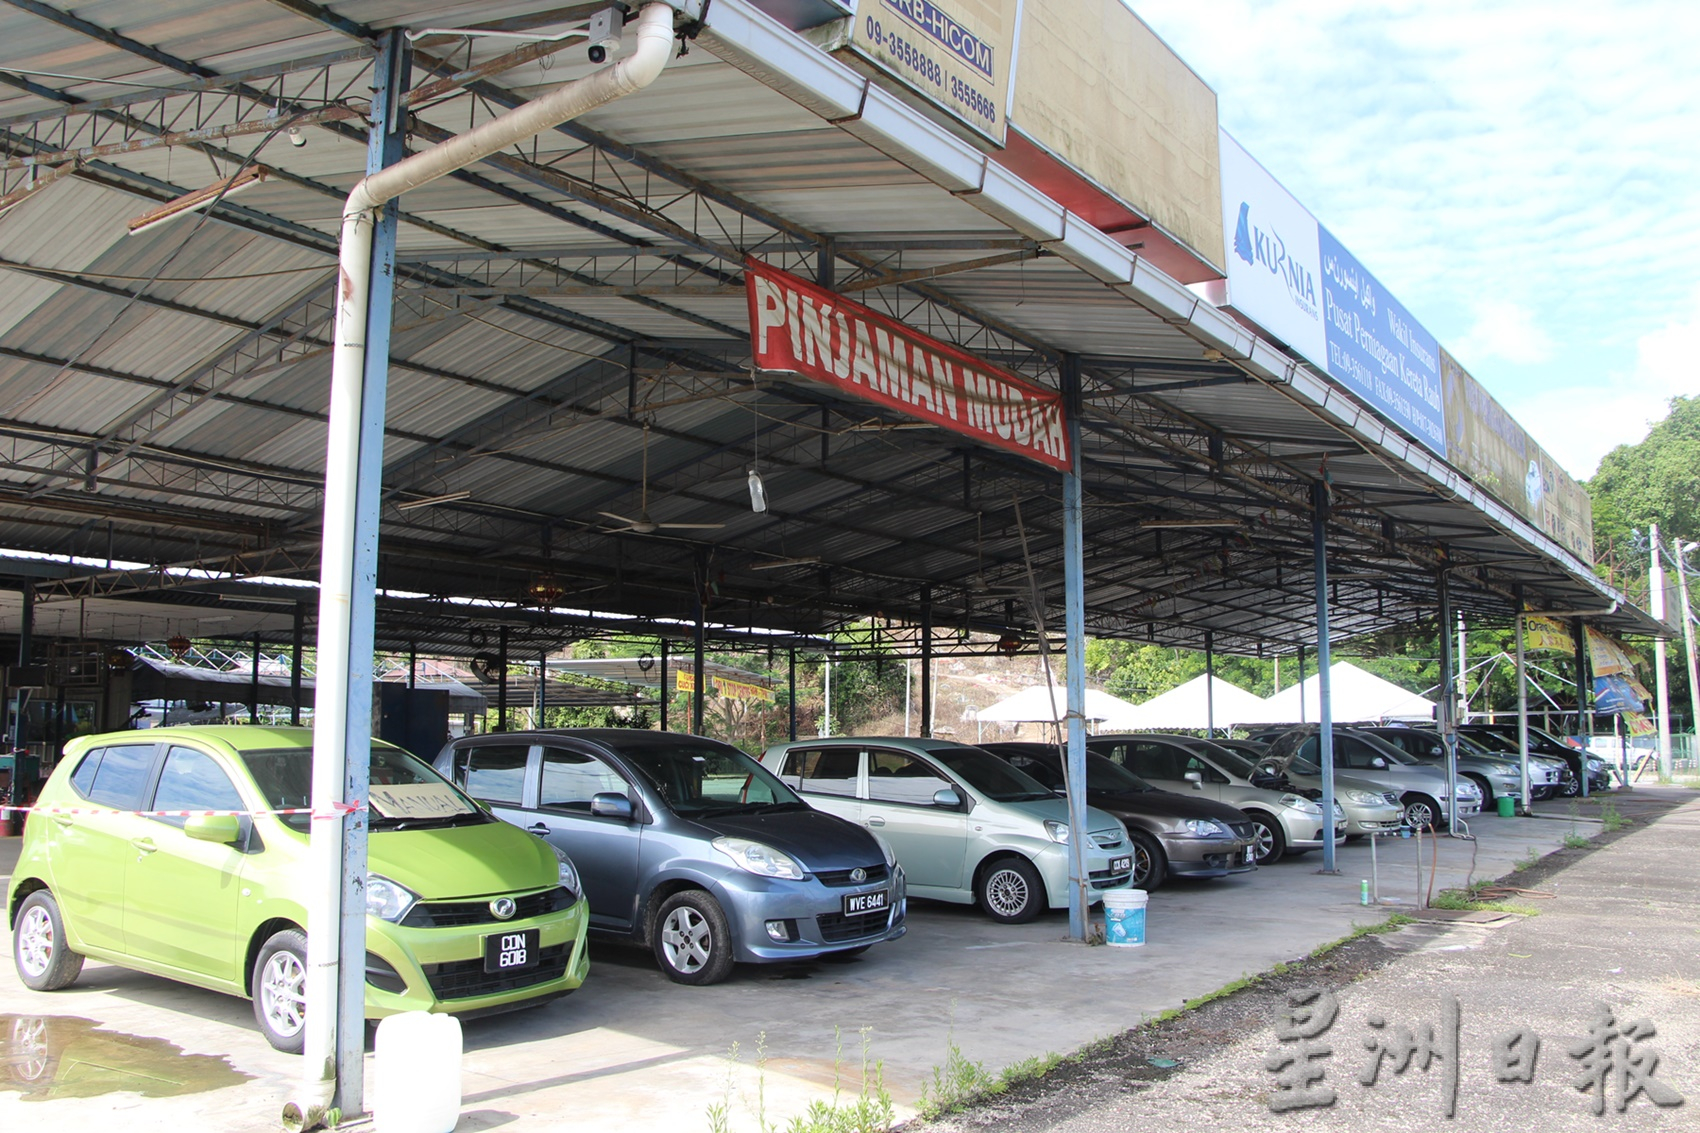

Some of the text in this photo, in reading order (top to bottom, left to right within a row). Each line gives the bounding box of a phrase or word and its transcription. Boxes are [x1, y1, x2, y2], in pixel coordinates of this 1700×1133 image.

[866, 15, 942, 87] 09-3558888
[951, 76, 996, 124] 3555666
[889, 0, 990, 72] RB-HICOM
[1253, 221, 1318, 307] KURNIA
[754, 275, 1067, 462] PINJAMAN MUDAH
[1326, 286, 1353, 339] Pusat
[1353, 312, 1400, 378] Perniagaan
[1399, 352, 1423, 398] Kereta
[1422, 374, 1441, 413] Raub
[1387, 307, 1409, 349] Wakil
[1409, 329, 1437, 374] Insurans
[370, 791, 468, 814] MANUAL
[849, 893, 884, 911] WYE 6441
[499, 949, 527, 968] 6018
[501, 933, 526, 951] CDN
